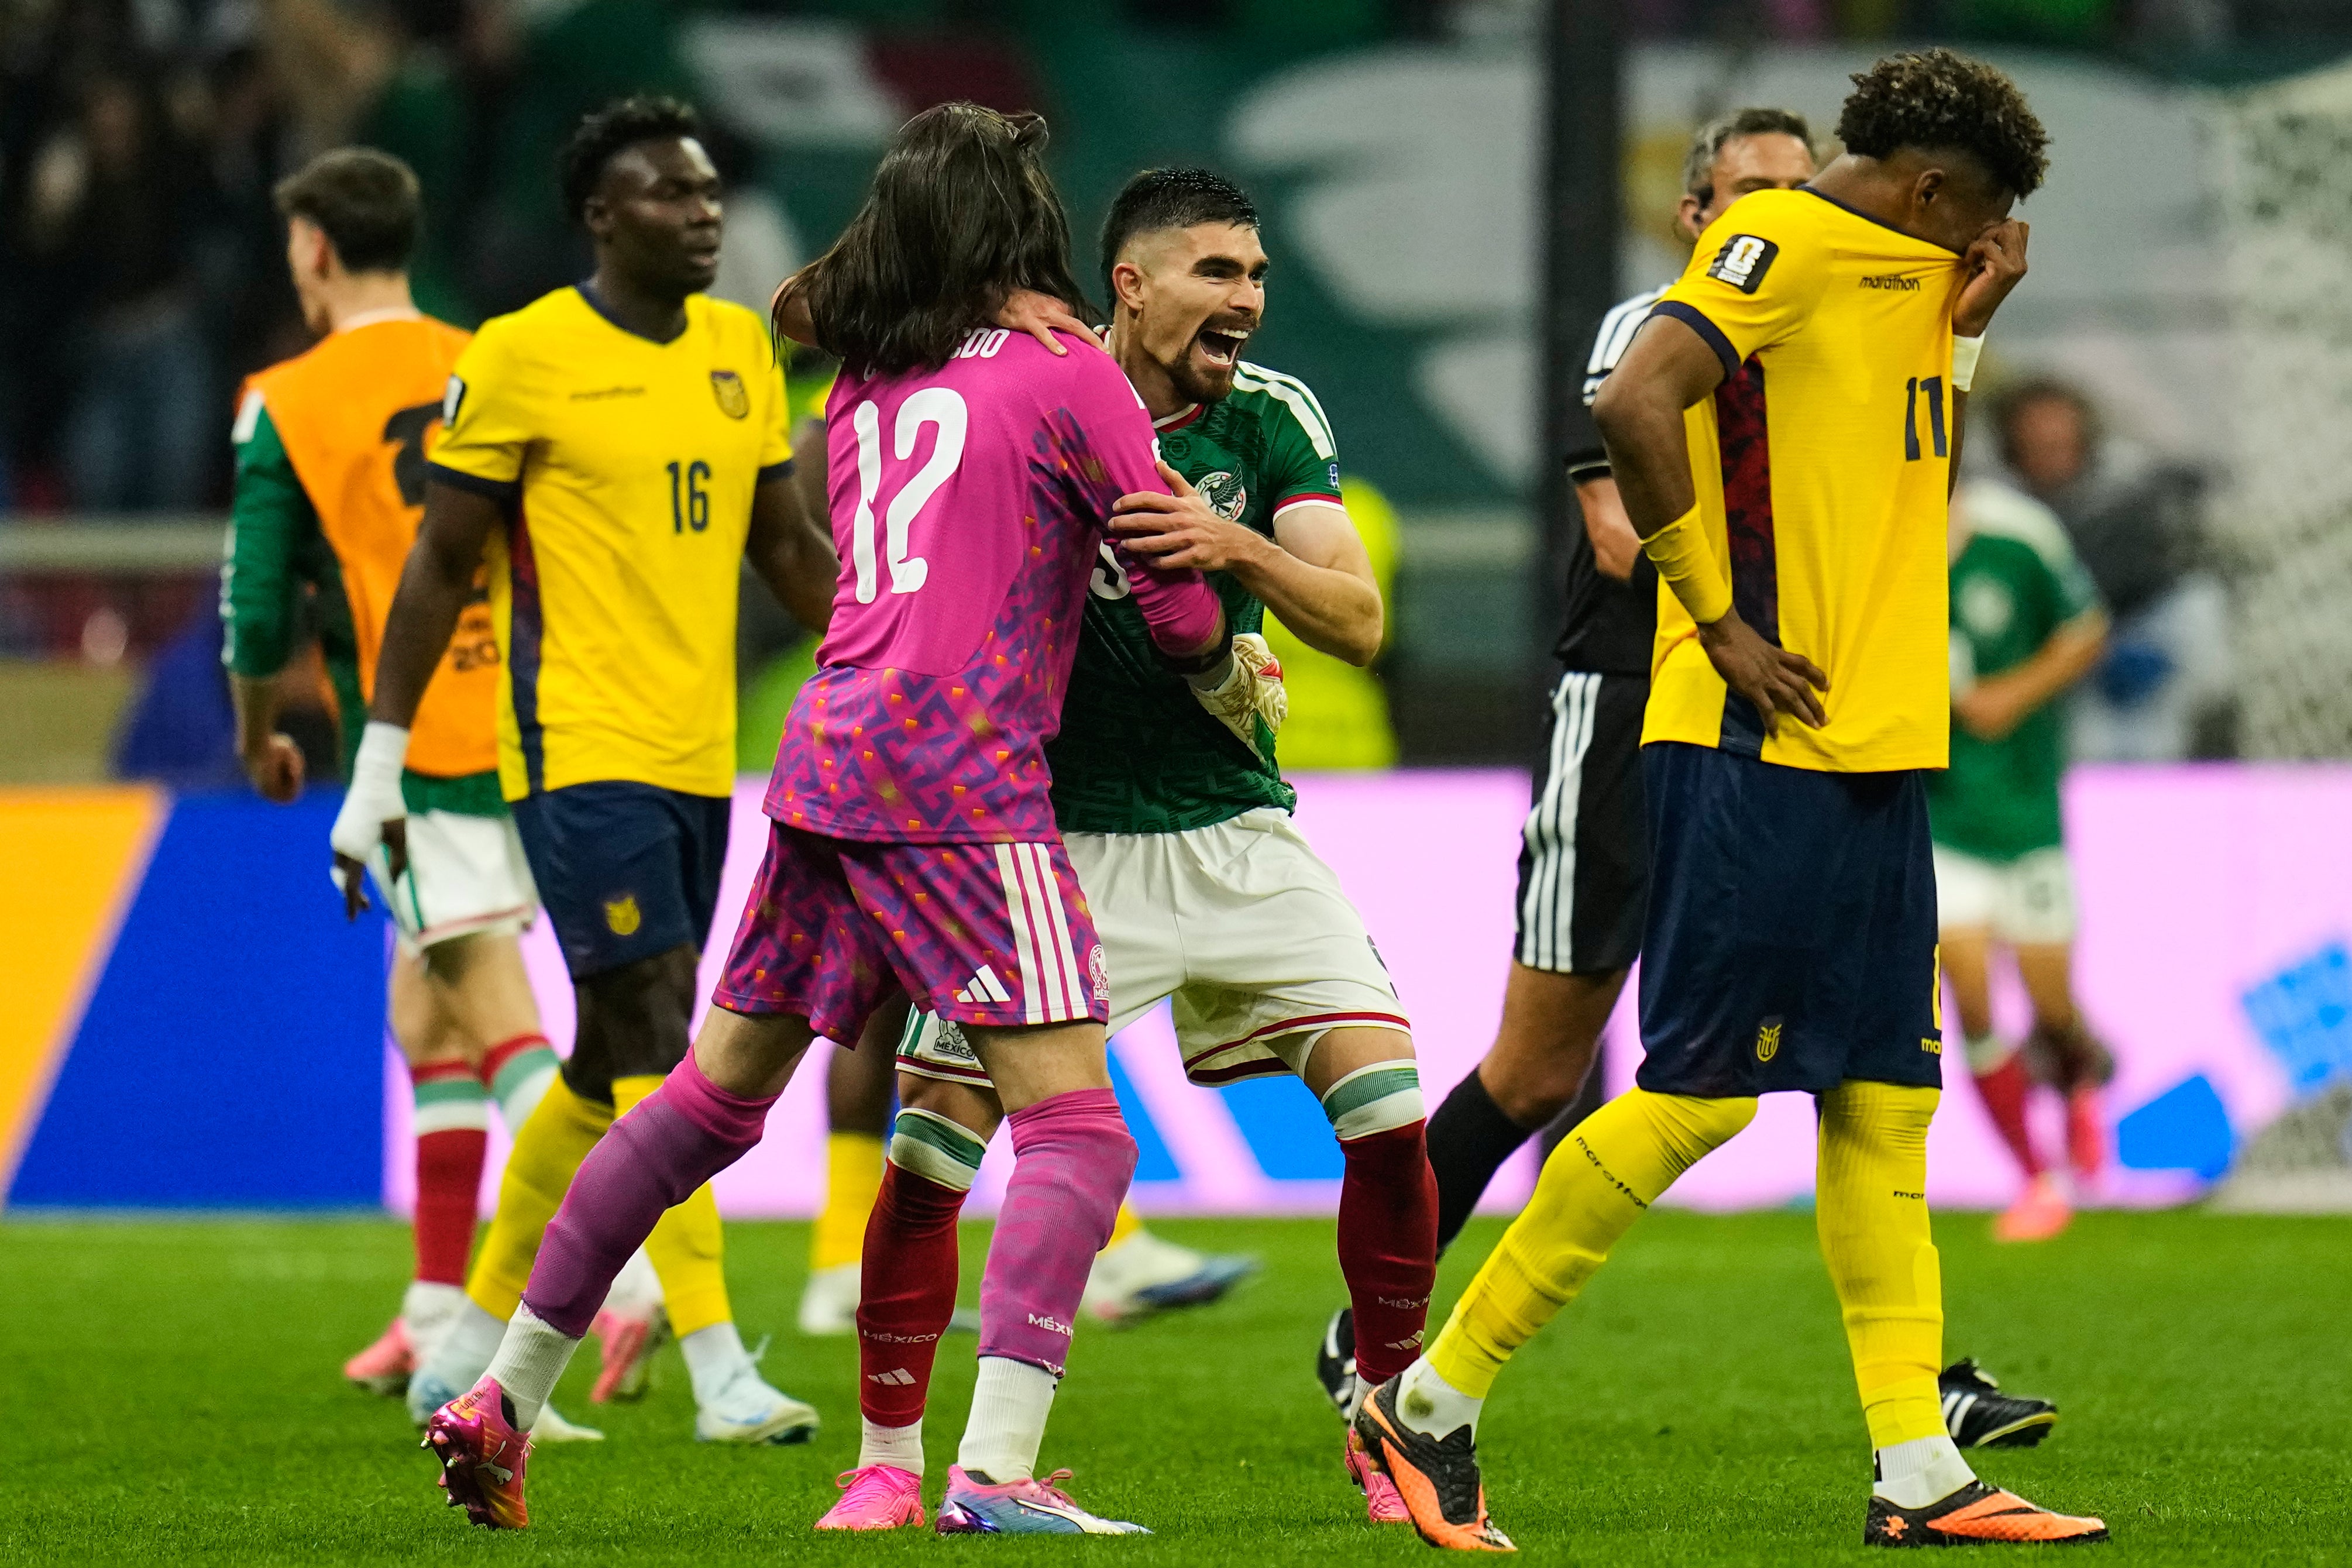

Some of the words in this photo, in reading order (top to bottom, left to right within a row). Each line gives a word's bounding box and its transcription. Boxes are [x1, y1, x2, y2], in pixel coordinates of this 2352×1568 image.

[1905, 376, 1947, 461] 11
[666, 460, 710, 532] 16
[853, 387, 968, 604] 12
[936, 1040, 974, 1057] MÉXICO
